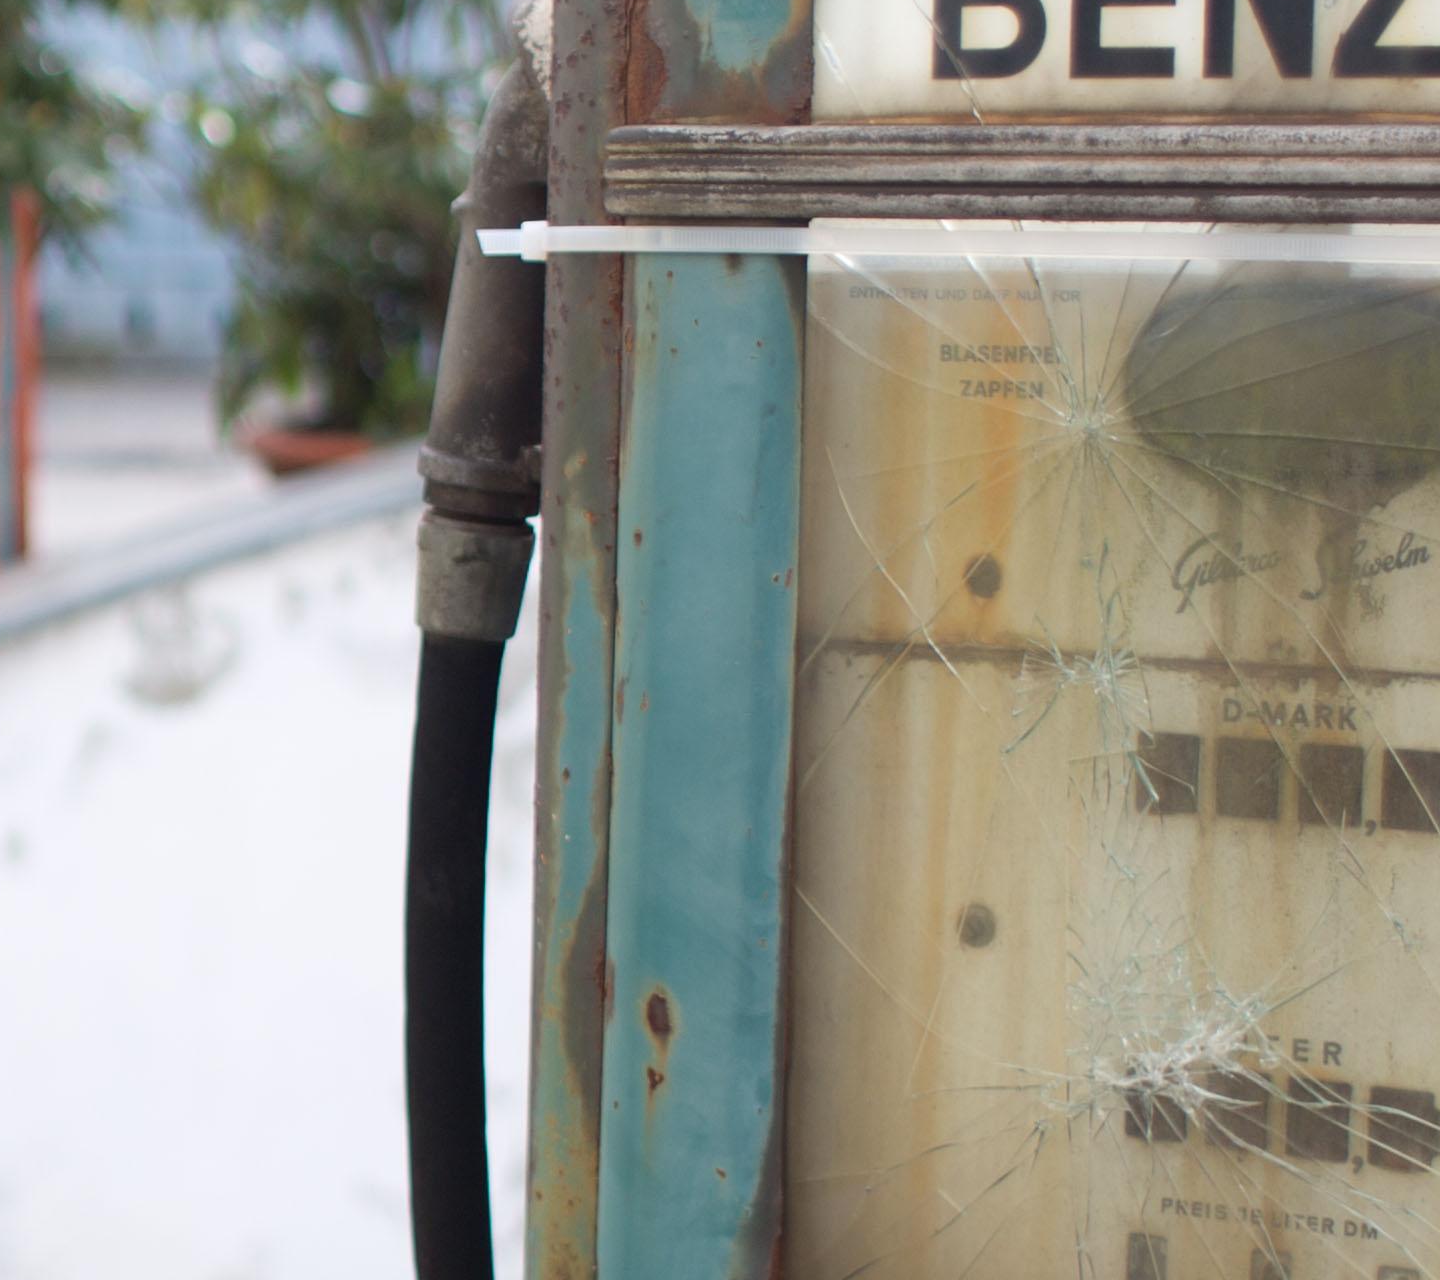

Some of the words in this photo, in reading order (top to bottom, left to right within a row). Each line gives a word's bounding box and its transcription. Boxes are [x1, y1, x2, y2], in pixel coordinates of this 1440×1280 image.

[1223, 697, 1358, 731] D-MARK
[1161, 1197, 1227, 1221] PREIS
[1343, 1219, 1379, 1240] DM
